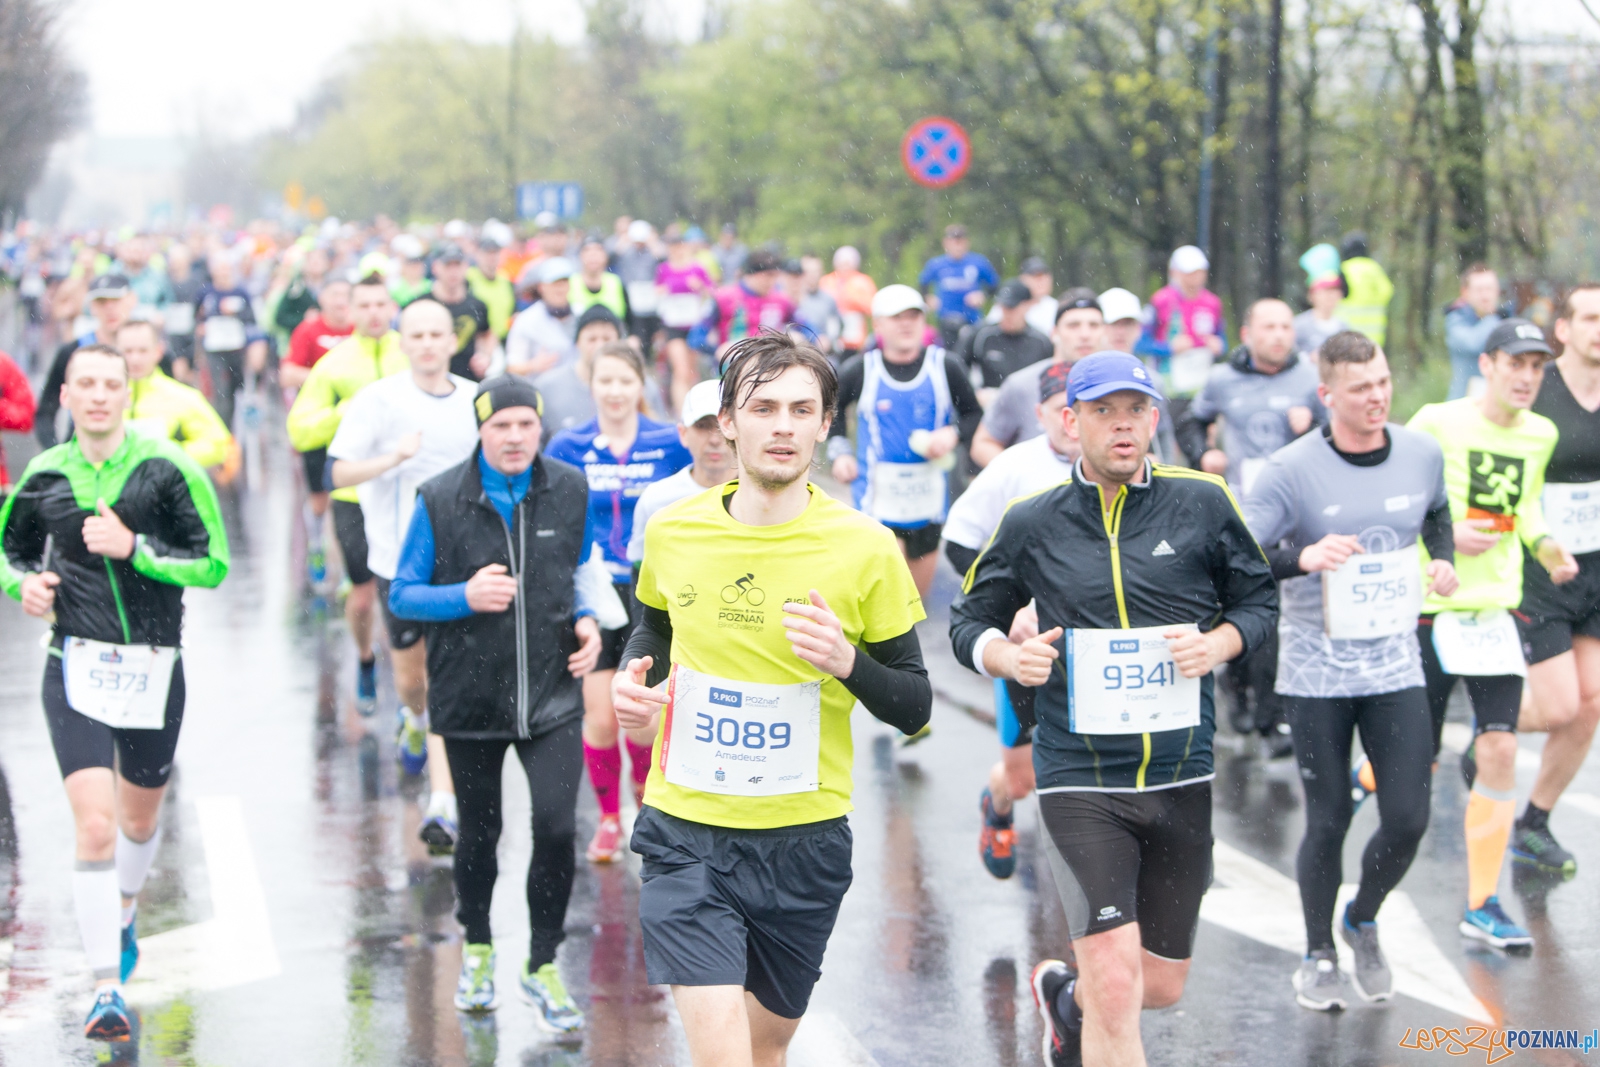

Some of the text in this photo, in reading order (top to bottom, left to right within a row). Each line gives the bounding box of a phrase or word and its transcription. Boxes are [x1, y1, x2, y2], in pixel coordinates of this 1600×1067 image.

[1562, 504, 1600, 525] 263
[1352, 576, 1407, 604] 5756
[717, 621, 764, 633] BikeChallenge
[1112, 642, 1136, 651] 9.PKO
[89, 669, 148, 692] 5373
[1103, 661, 1175, 690] 9341
[712, 692, 738, 703] 9.PKO
[1125, 693, 1158, 701] Tomasz
[695, 711, 791, 750] 3089
[714, 749, 767, 763] Amadeusz
